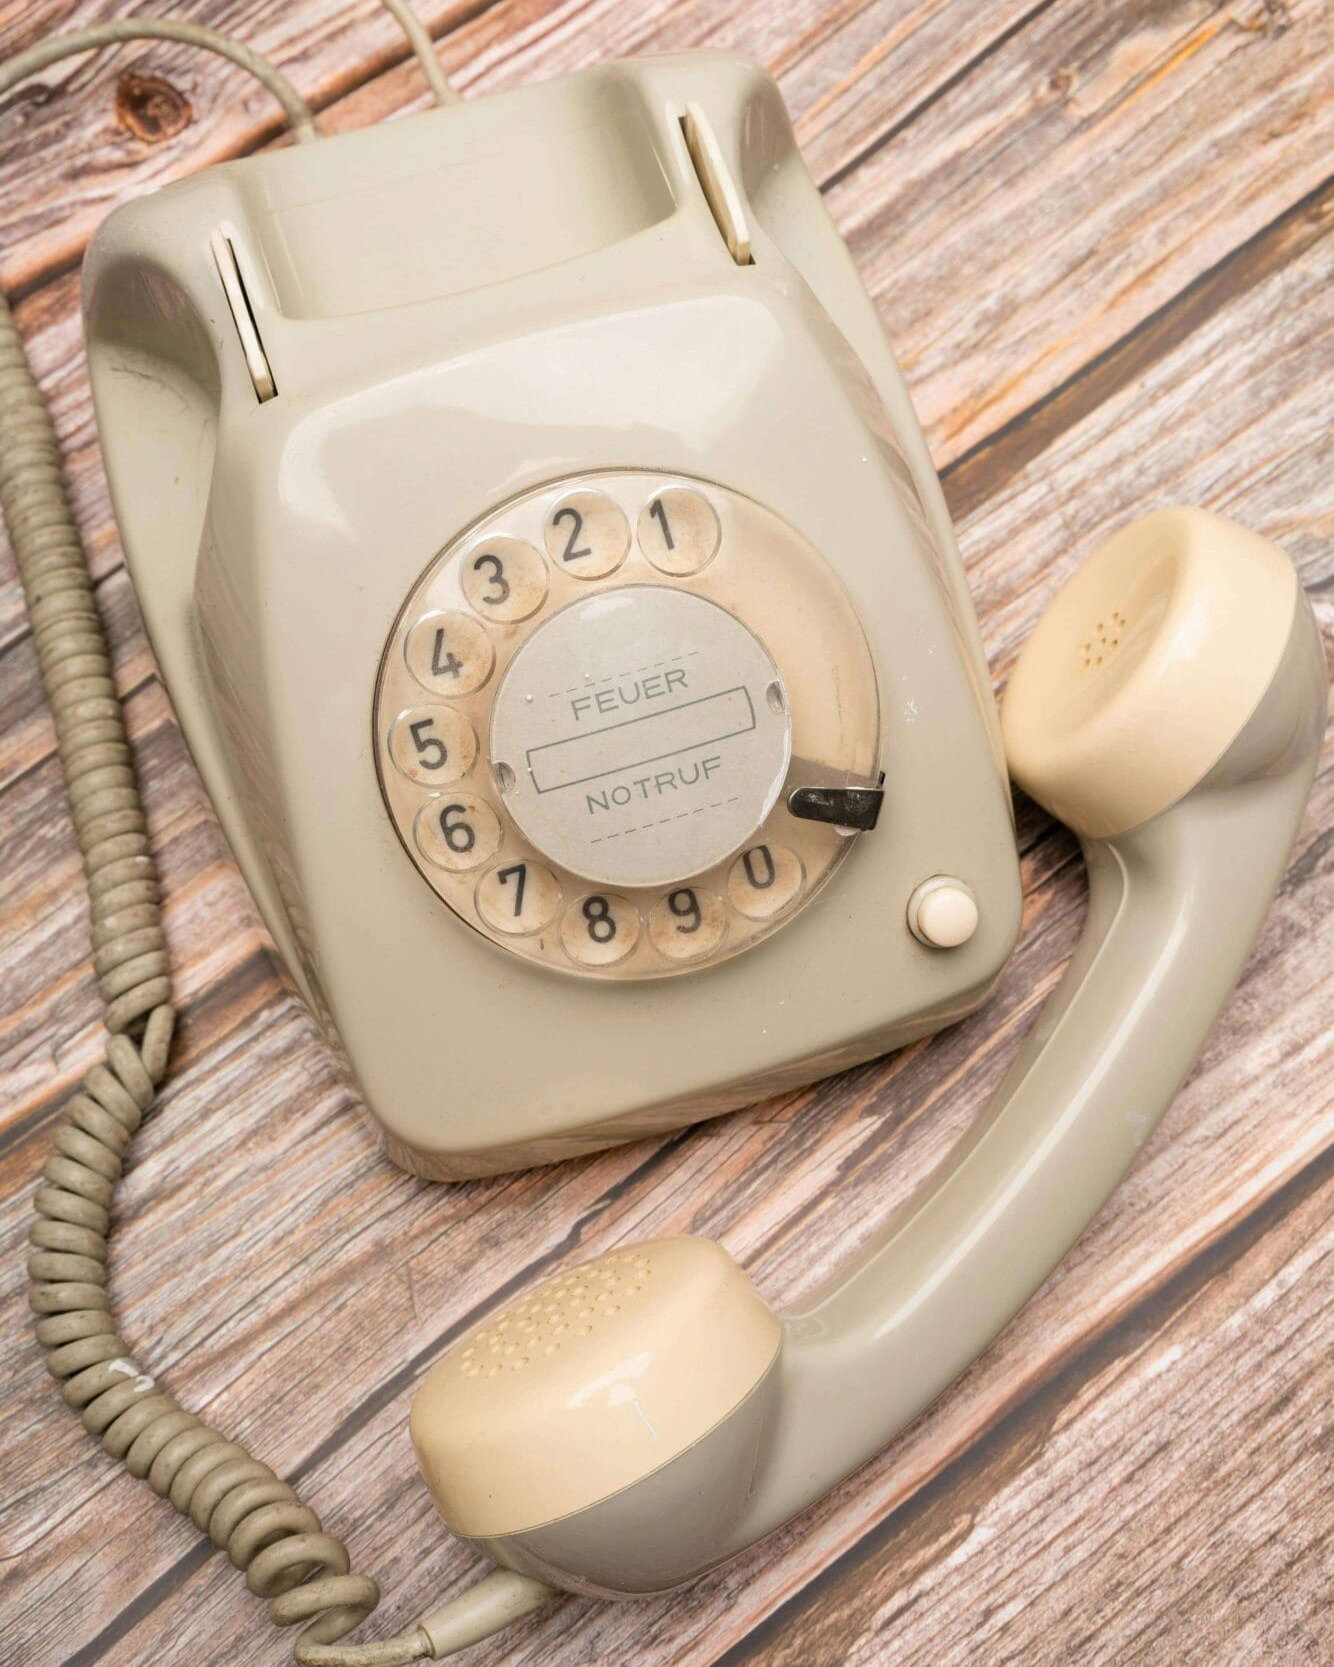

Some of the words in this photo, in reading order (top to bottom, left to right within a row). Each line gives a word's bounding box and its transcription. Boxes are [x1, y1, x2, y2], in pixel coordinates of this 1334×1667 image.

[552, 507, 592, 562] 2
[649, 500, 675, 550] 1
[473, 554, 509, 605] 3
[430, 628, 463, 679] 4
[571, 669, 688, 721] FEUER
[409, 718, 448, 770] 5
[585, 755, 721, 815] NOTRUF
[439, 803, 476, 853] 6
[497, 864, 527, 917] 7
[742, 845, 775, 890] 0
[581, 895, 617, 943] 8
[668, 888, 701, 933] 9
